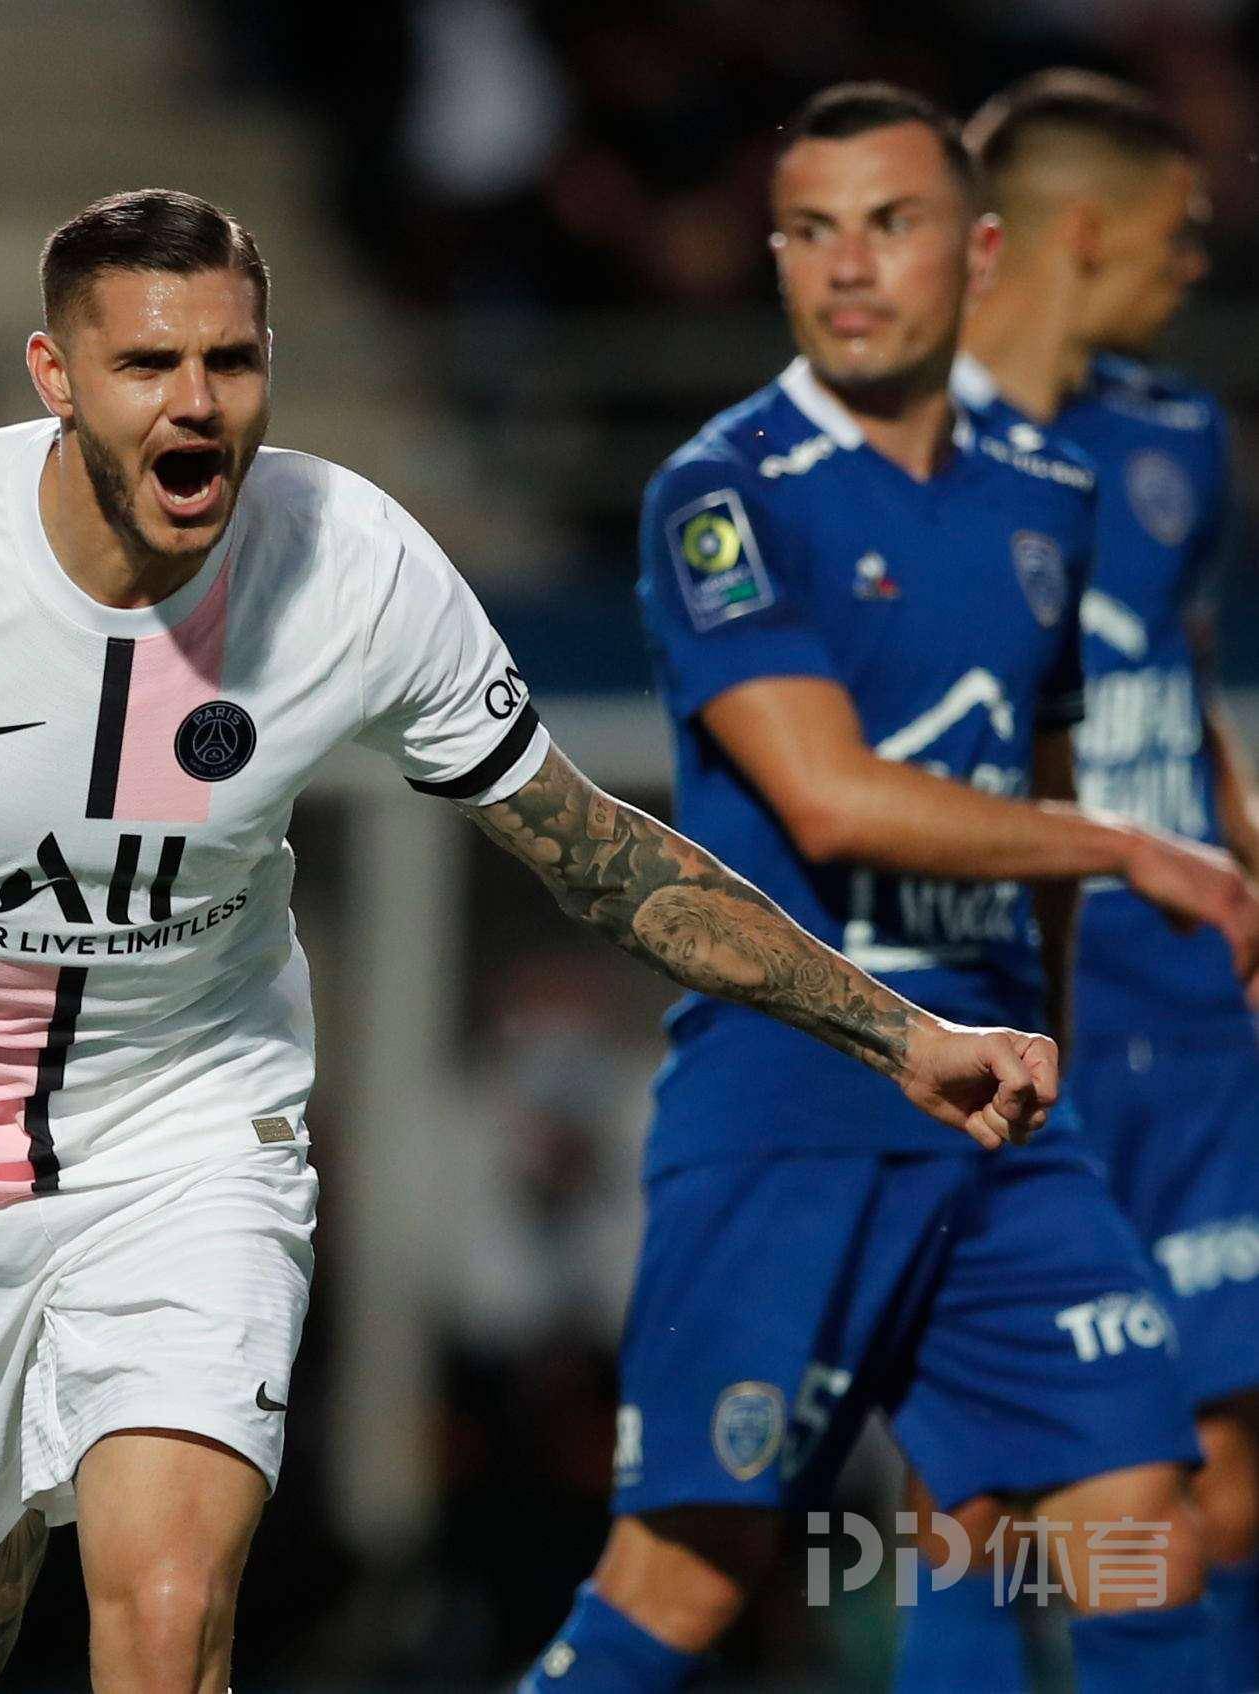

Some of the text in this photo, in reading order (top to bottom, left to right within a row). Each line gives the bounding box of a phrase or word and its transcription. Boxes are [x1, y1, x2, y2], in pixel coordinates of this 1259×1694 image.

[193, 707, 242, 726] PARIS
[20, 931, 96, 954] LIVE
[108, 888, 247, 954] LIMITLESS
